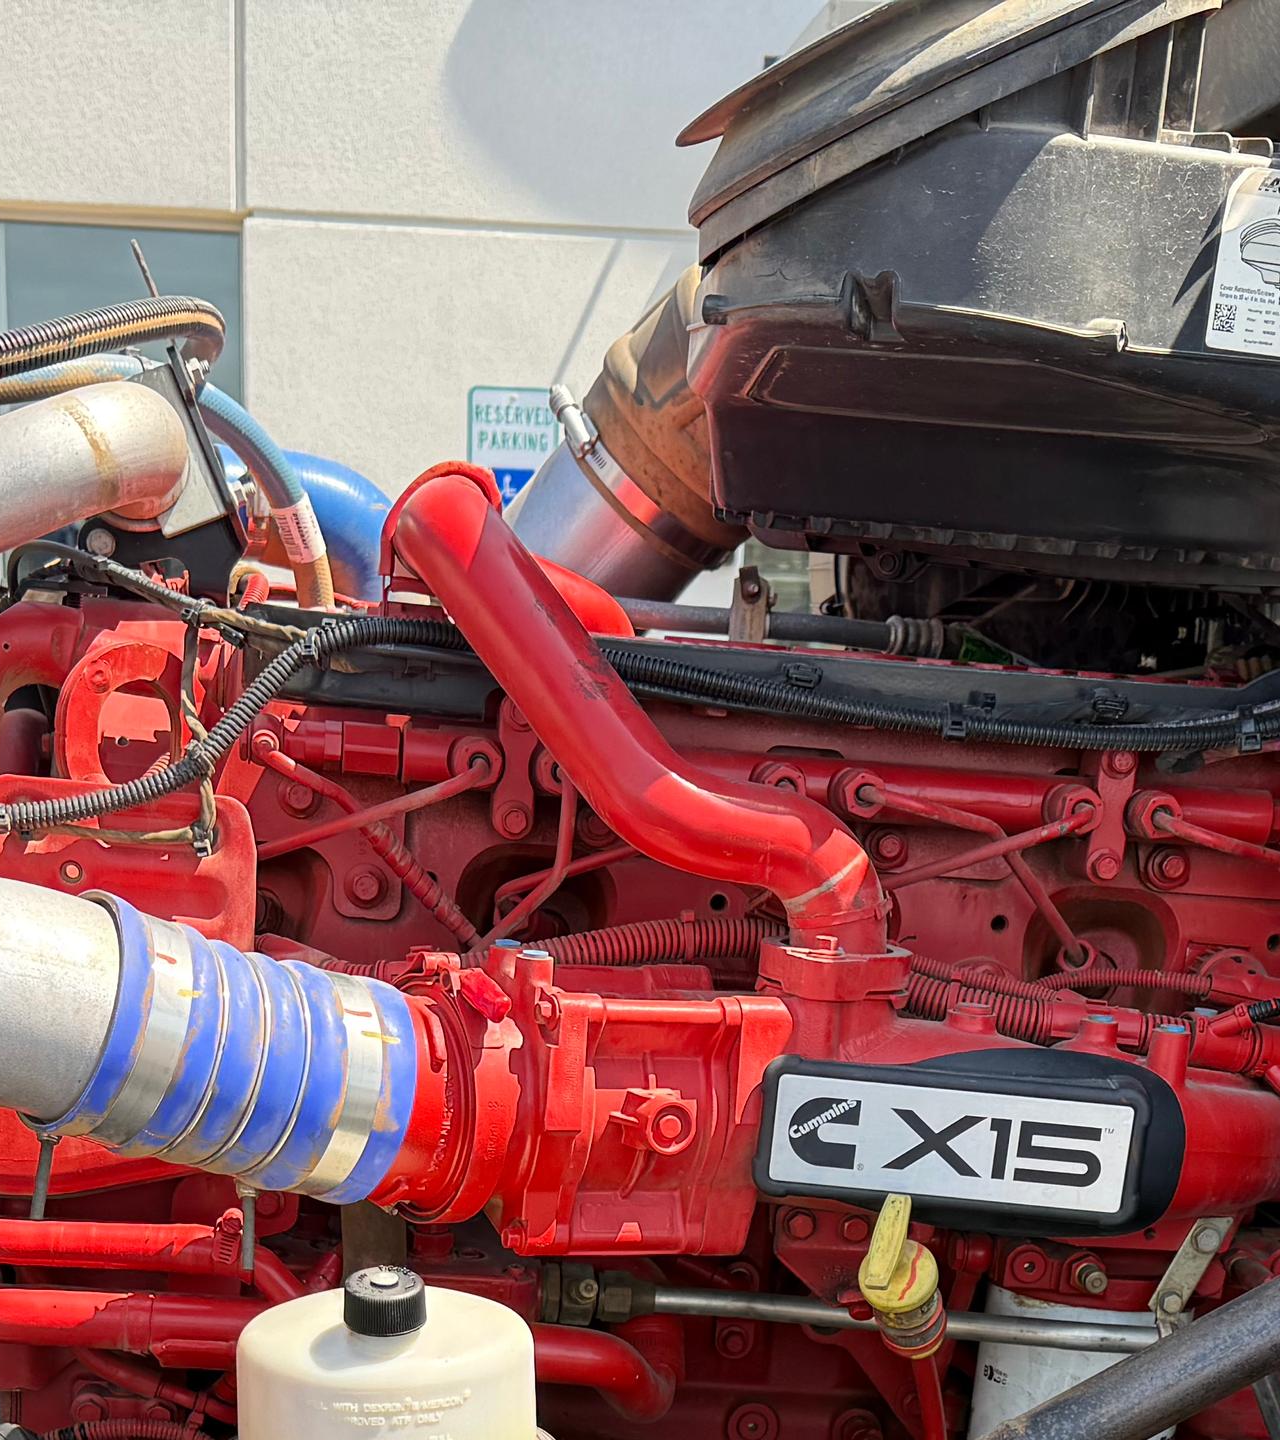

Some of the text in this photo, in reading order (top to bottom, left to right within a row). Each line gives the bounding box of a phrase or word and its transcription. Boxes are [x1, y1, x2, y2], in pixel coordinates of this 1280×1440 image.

[475, 405, 555, 425] RESERVED
[477, 430, 548, 452] PARKING
[789, 1098, 857, 1139] Cummins
[881, 1107, 1103, 1188] X15
[333, 1402, 358, 1412] WITH
